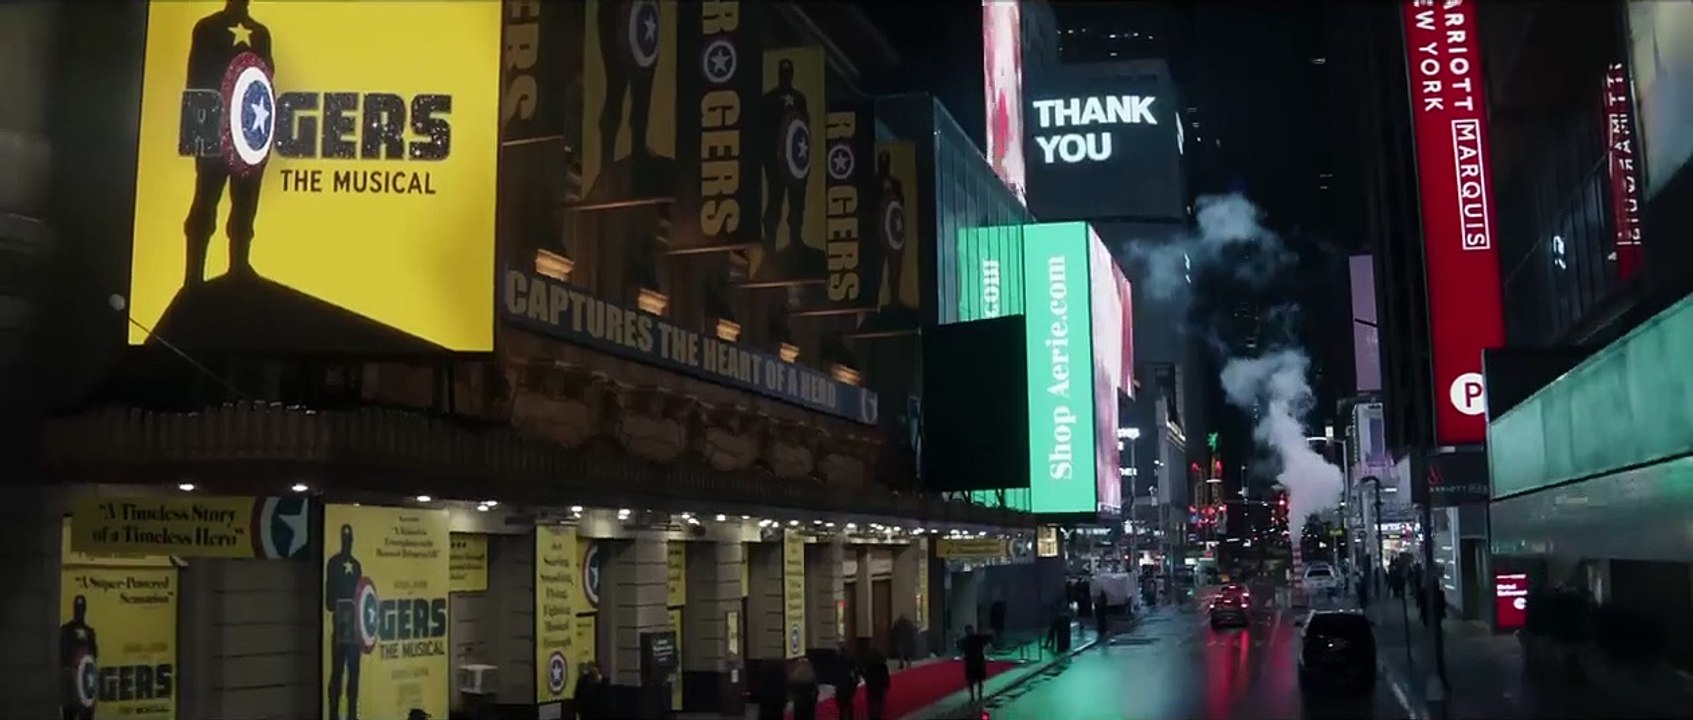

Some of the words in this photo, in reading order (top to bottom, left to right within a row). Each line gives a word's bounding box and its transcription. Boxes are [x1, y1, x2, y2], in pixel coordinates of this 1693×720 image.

[1418, 42, 1444, 112] YORK
[1033, 95, 1157, 128] THANK
[1035, 132, 1112, 163] YOU
[281, 170, 322, 192] THE
[333, 170, 436, 194] MUSICAL
[1455, 122, 1487, 246] MARQUIS
[506, 270, 653, 353] CAPTURES
[657, 322, 699, 366] THE
[703, 337, 763, 384] HEART
[765, 361, 787, 391] OF
[787, 367, 799, 394] A
[1046, 254, 1071, 399] Aerie.com
[1465, 382, 1482, 407] P
[1048, 405, 1077, 481] Shop
[121, 503, 190, 522] Timeless
[192, 504, 236, 528] Story
[92, 526, 108, 544] of
[110, 530, 120, 543] a
[122, 525, 192, 545] Timeless
[379, 643, 399, 660] THE
[402, 641, 446, 659] MUSICAL
